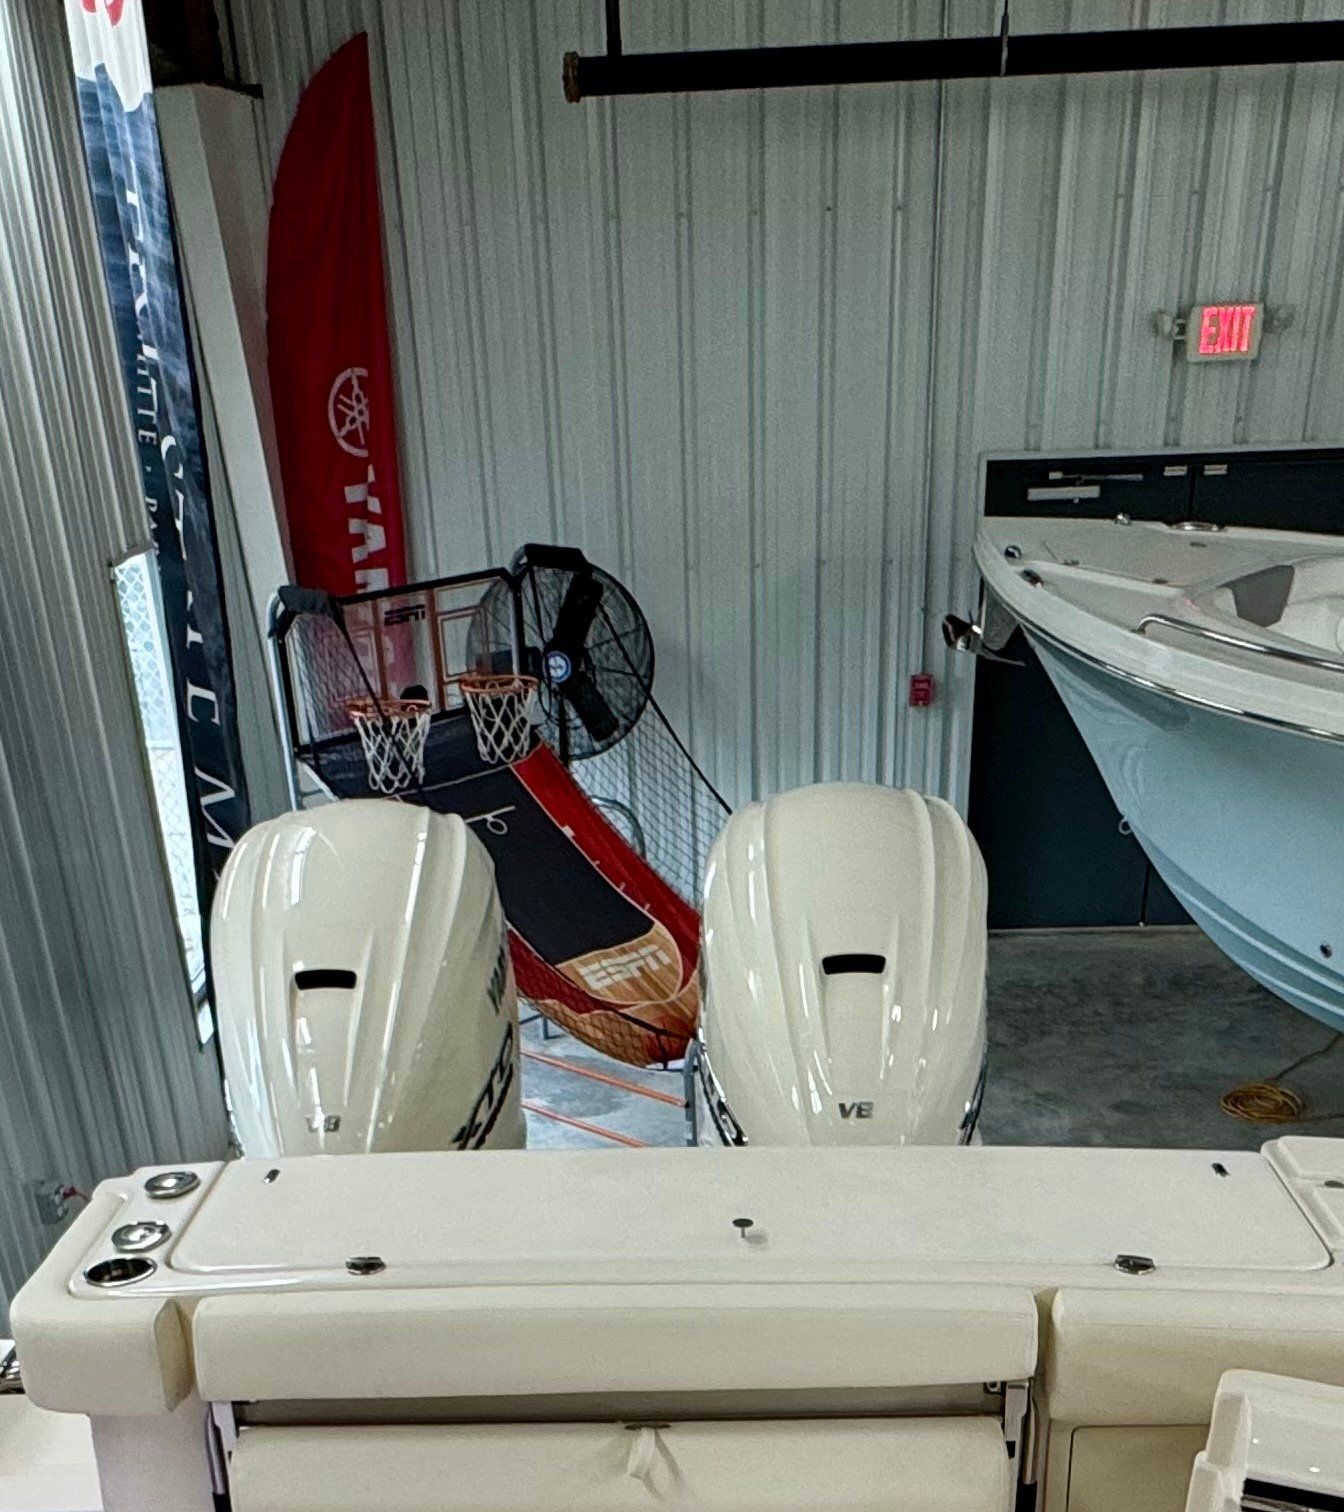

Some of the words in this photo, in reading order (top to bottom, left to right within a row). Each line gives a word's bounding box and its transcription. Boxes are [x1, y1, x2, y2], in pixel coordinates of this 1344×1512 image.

[1199, 305, 1255, 354] EXIT
[384, 603, 426, 626] ESPN
[577, 943, 673, 991] ESPN
